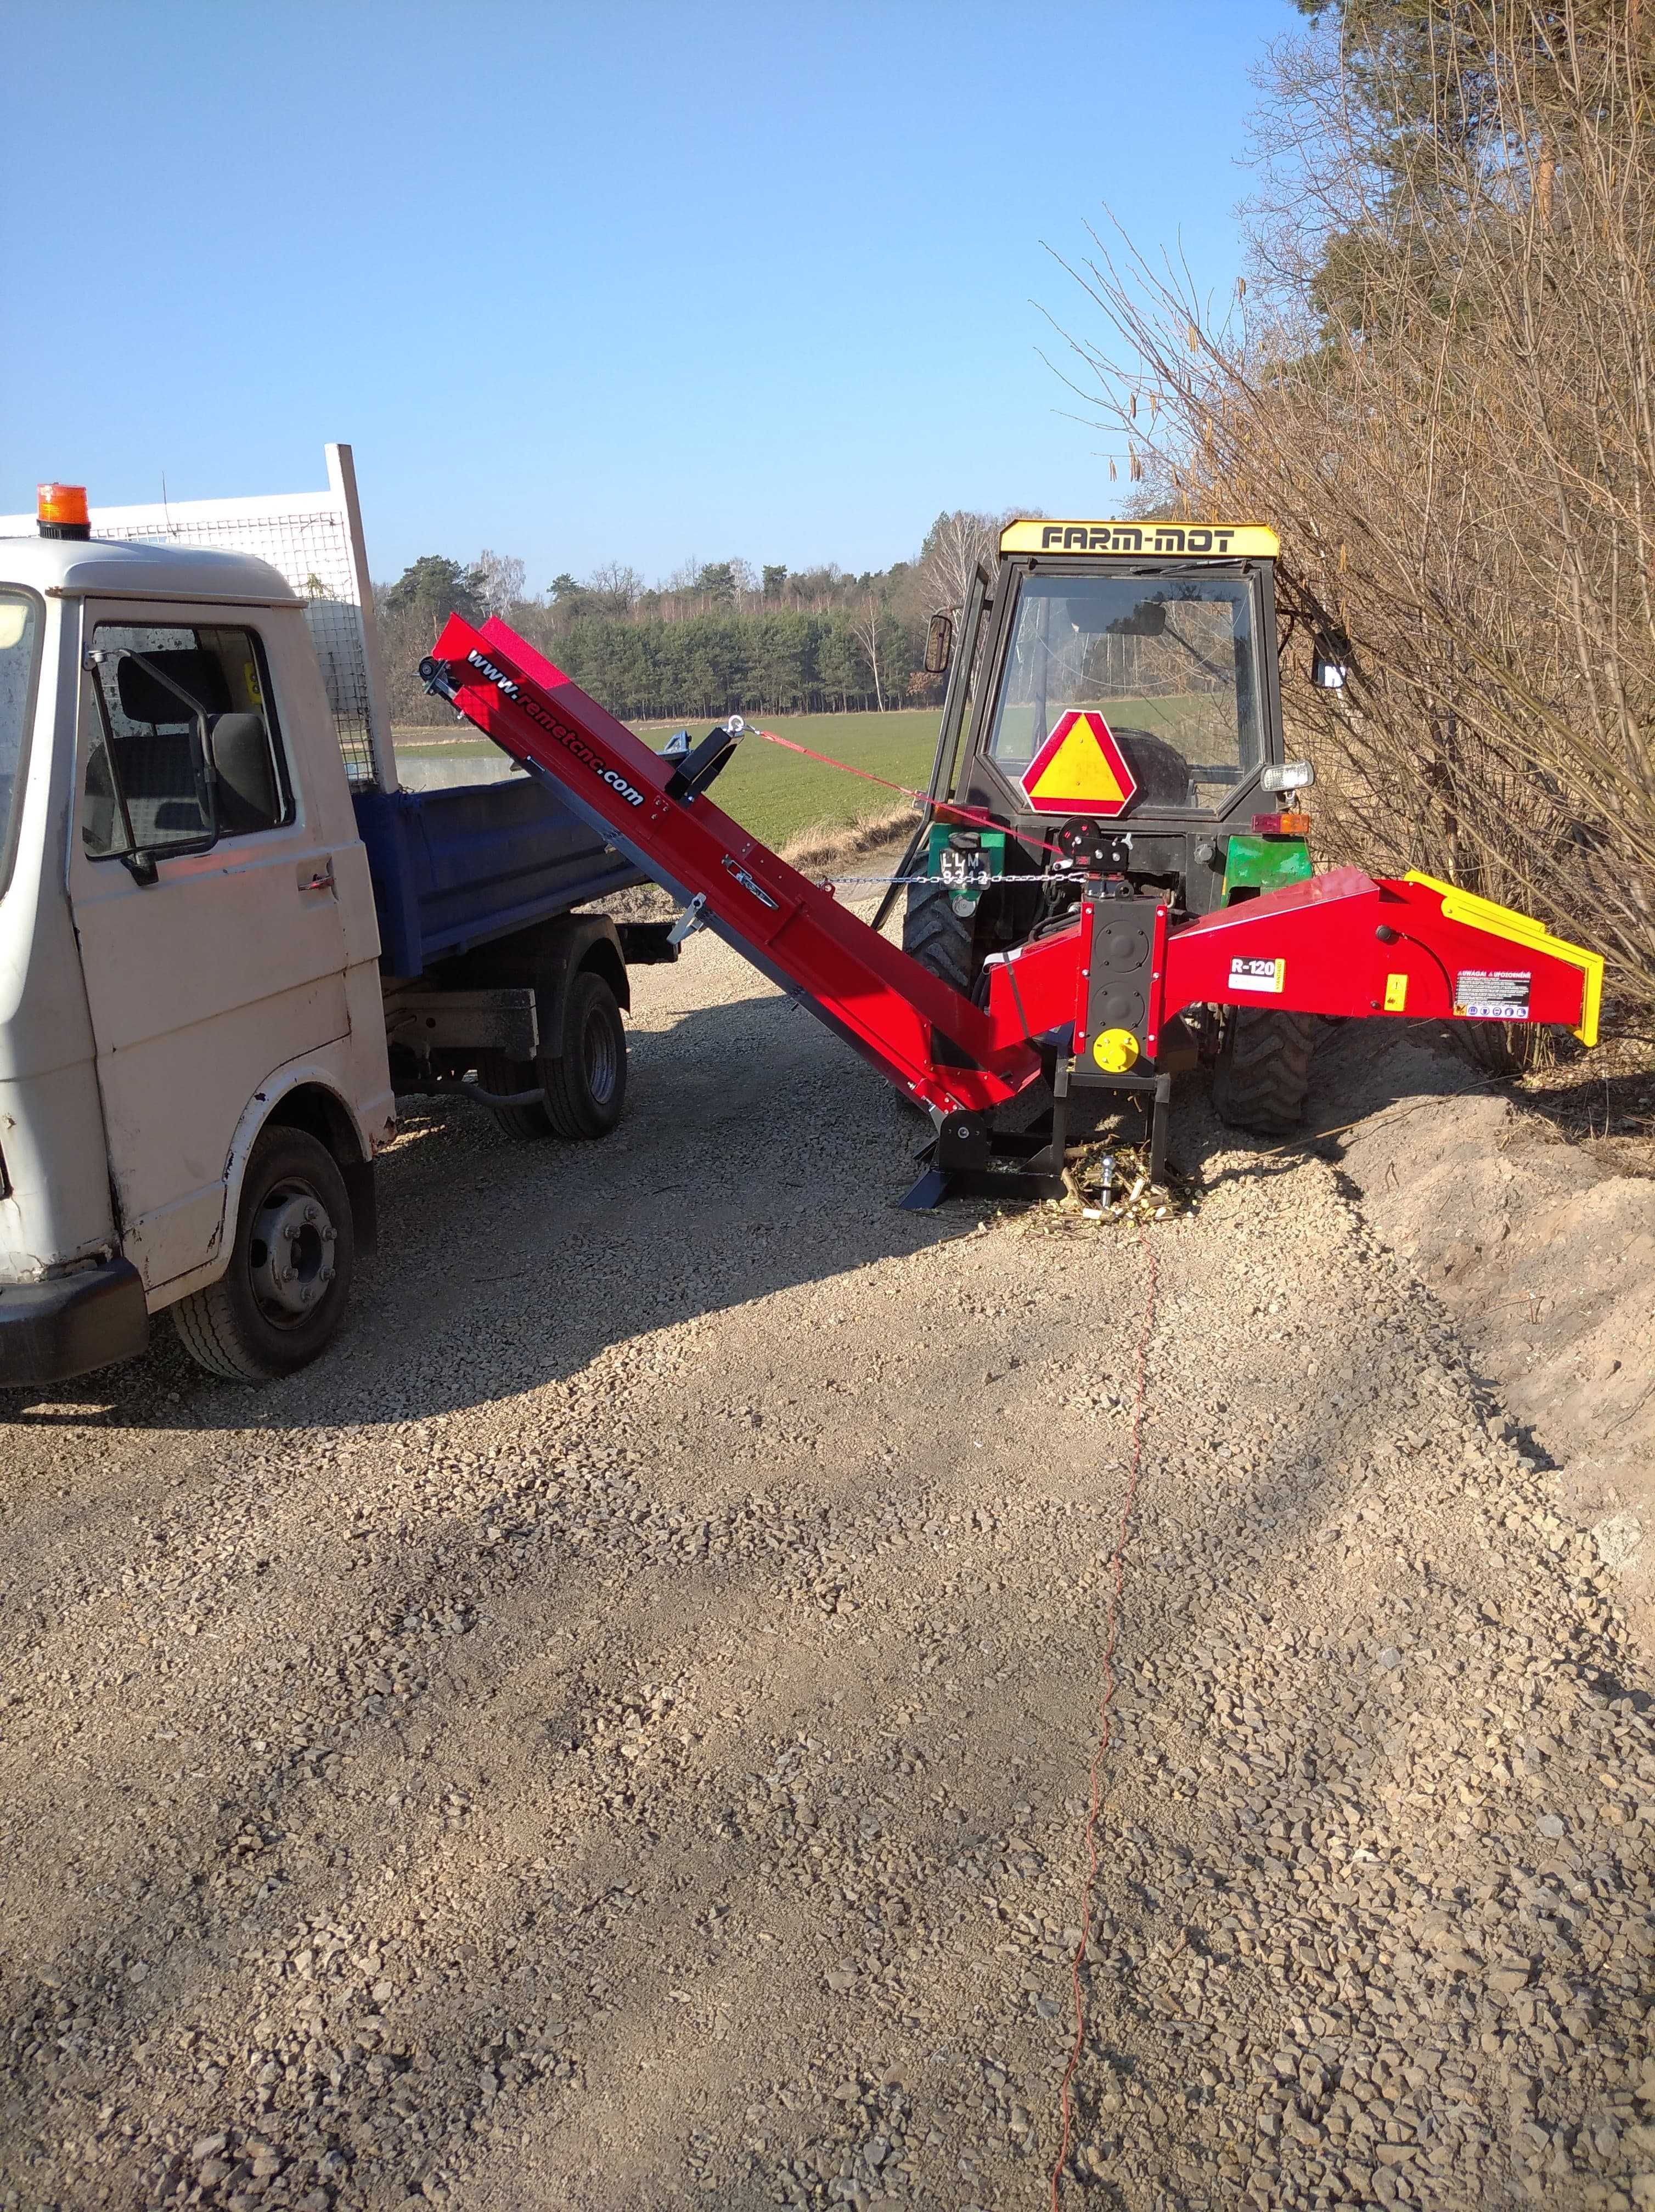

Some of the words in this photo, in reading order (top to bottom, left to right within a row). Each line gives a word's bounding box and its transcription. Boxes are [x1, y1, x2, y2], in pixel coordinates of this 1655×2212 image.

[1042, 526, 1234, 552] FARM-MOT
[466, 649, 645, 806] www.remetcnc.com
[943, 853, 979, 867] LLM
[1232, 959, 1274, 975] R-120
